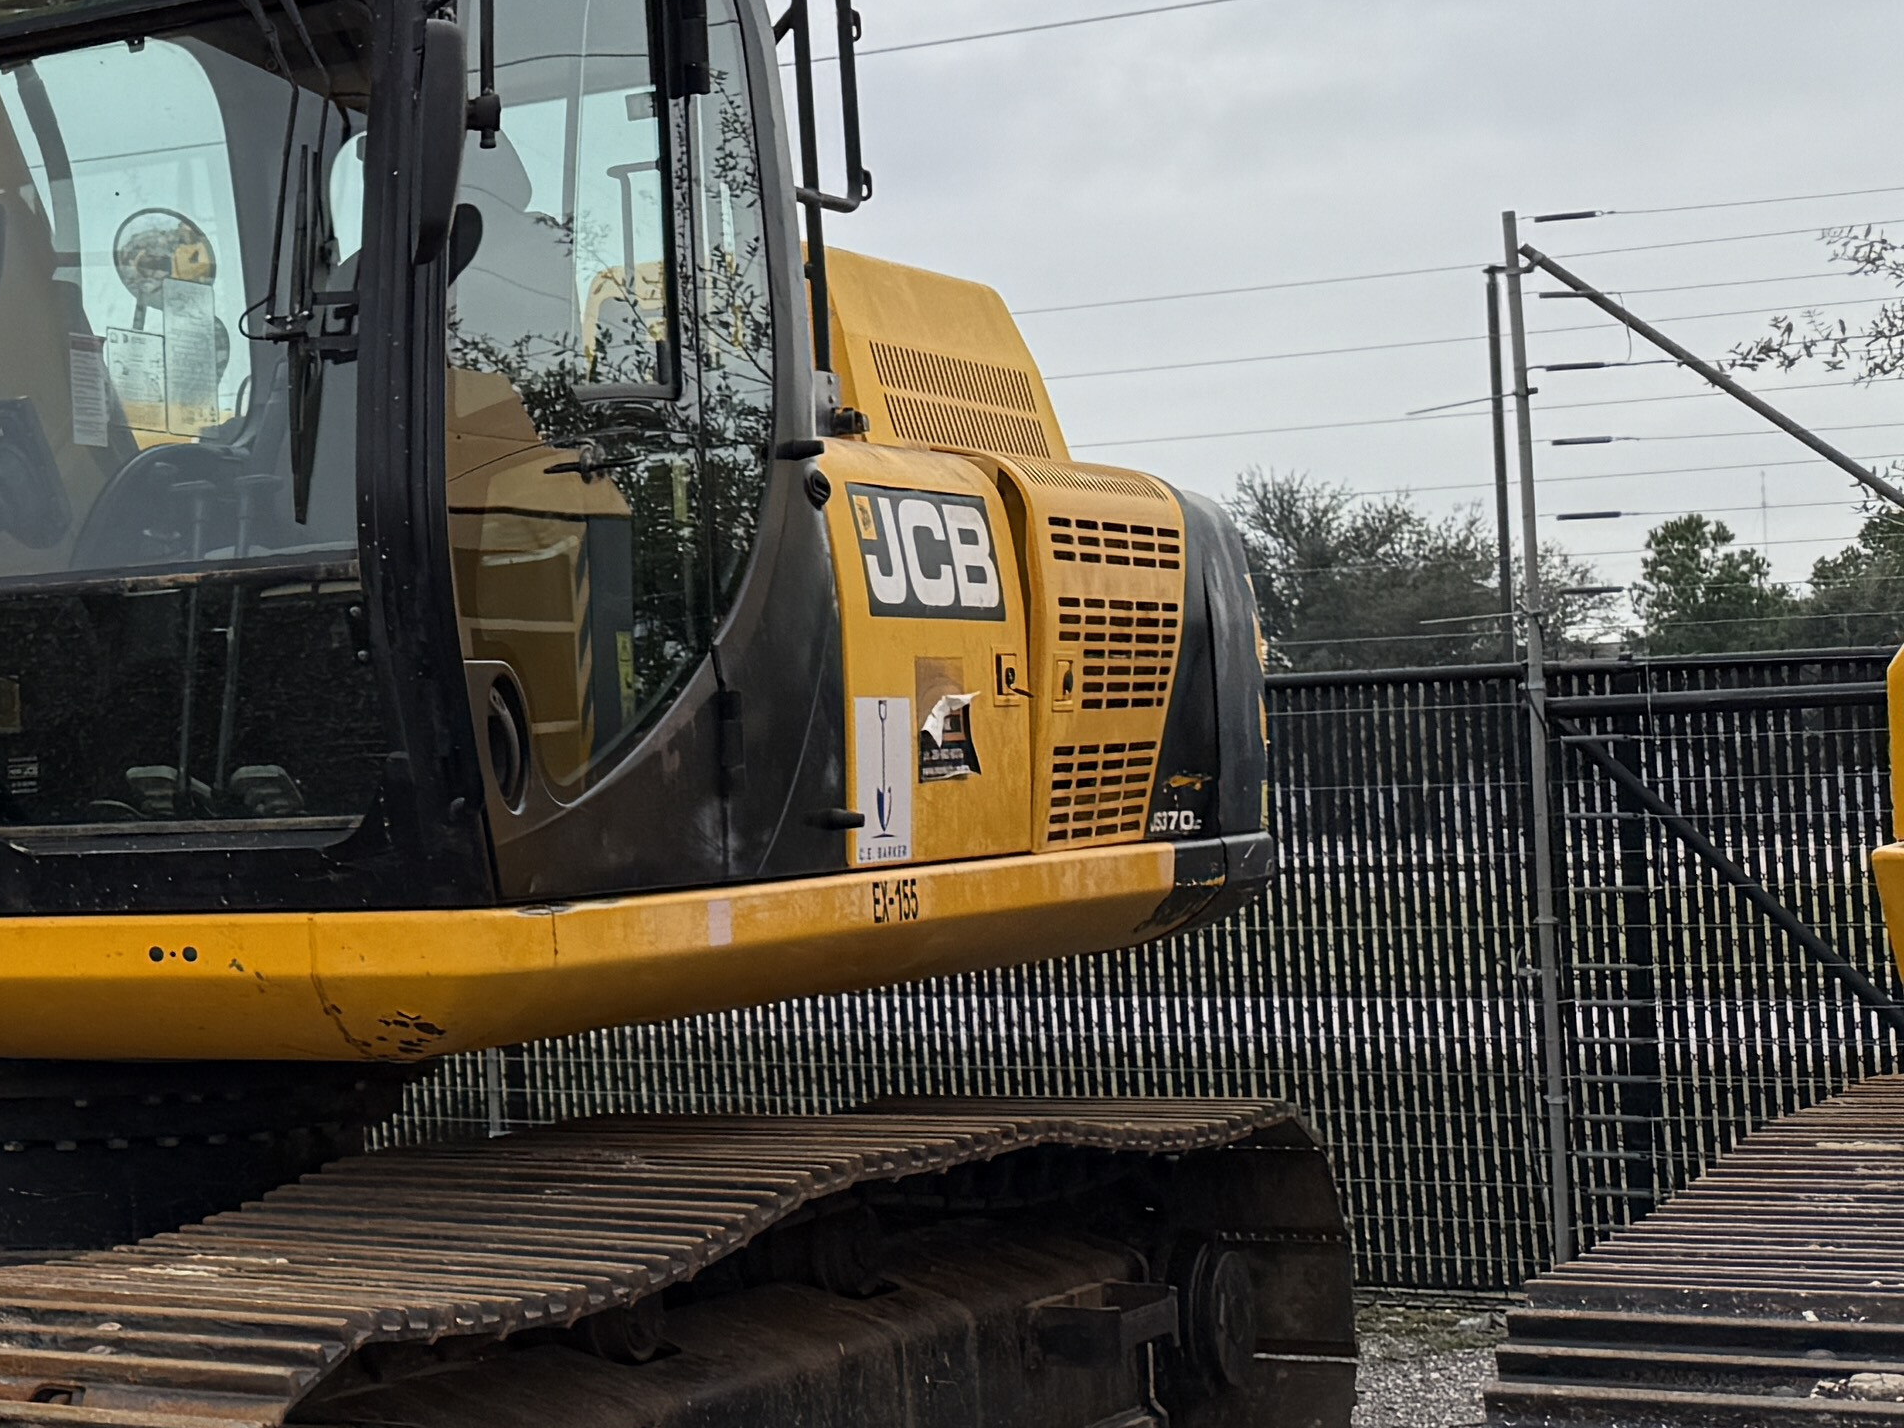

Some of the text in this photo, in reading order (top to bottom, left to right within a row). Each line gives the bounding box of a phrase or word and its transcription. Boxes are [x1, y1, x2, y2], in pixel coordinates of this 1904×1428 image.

[865, 496, 1000, 608] JCB
[878, 844, 908, 860] BARKER
[872, 878, 919, 924] EX-155
